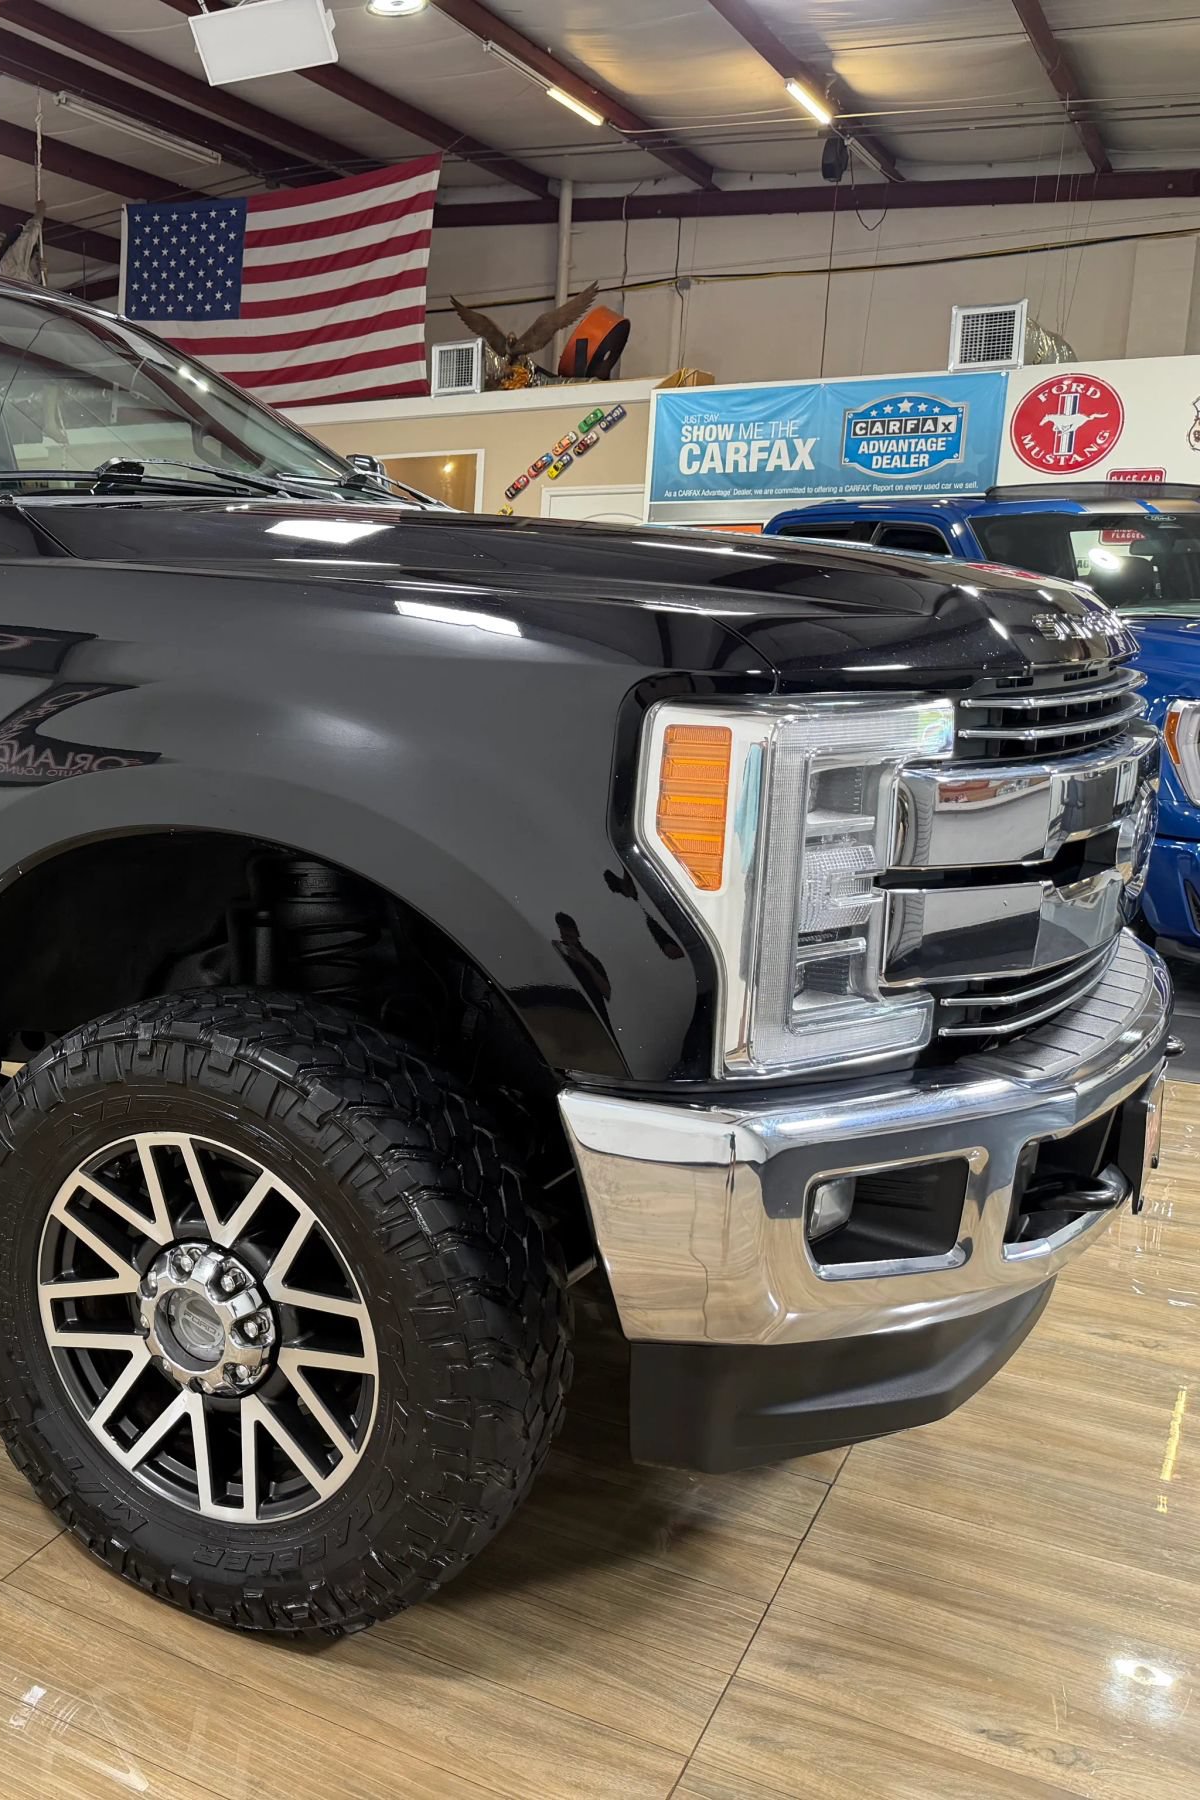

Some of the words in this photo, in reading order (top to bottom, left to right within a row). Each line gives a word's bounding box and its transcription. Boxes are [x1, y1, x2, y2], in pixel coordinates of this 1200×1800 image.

[1037, 382, 1101, 403] FORD
[681, 414, 701, 424] JUST
[703, 413, 720, 423] SAY
[681, 423, 735, 443] SHOW
[738, 422, 764, 440] ME
[769, 420, 800, 438] THE
[854, 419, 953, 435] CARFAX
[858, 438, 947, 454] ADVANTAGE
[1021, 430, 1111, 465] MUSTANG
[679, 437, 817, 475] CARFAX
[871, 454, 930, 469] DEALER
[1141, 474, 1161, 483] CAR
[664, 489, 672, 497] As
[678, 489, 701, 497] CARFAX
[774, 486, 805, 494] committed
[814, 485, 837, 494] offering
[872, 484, 894, 492] Report
[923, 482, 940, 490] used
[184, 1311, 217, 1335] FORD
